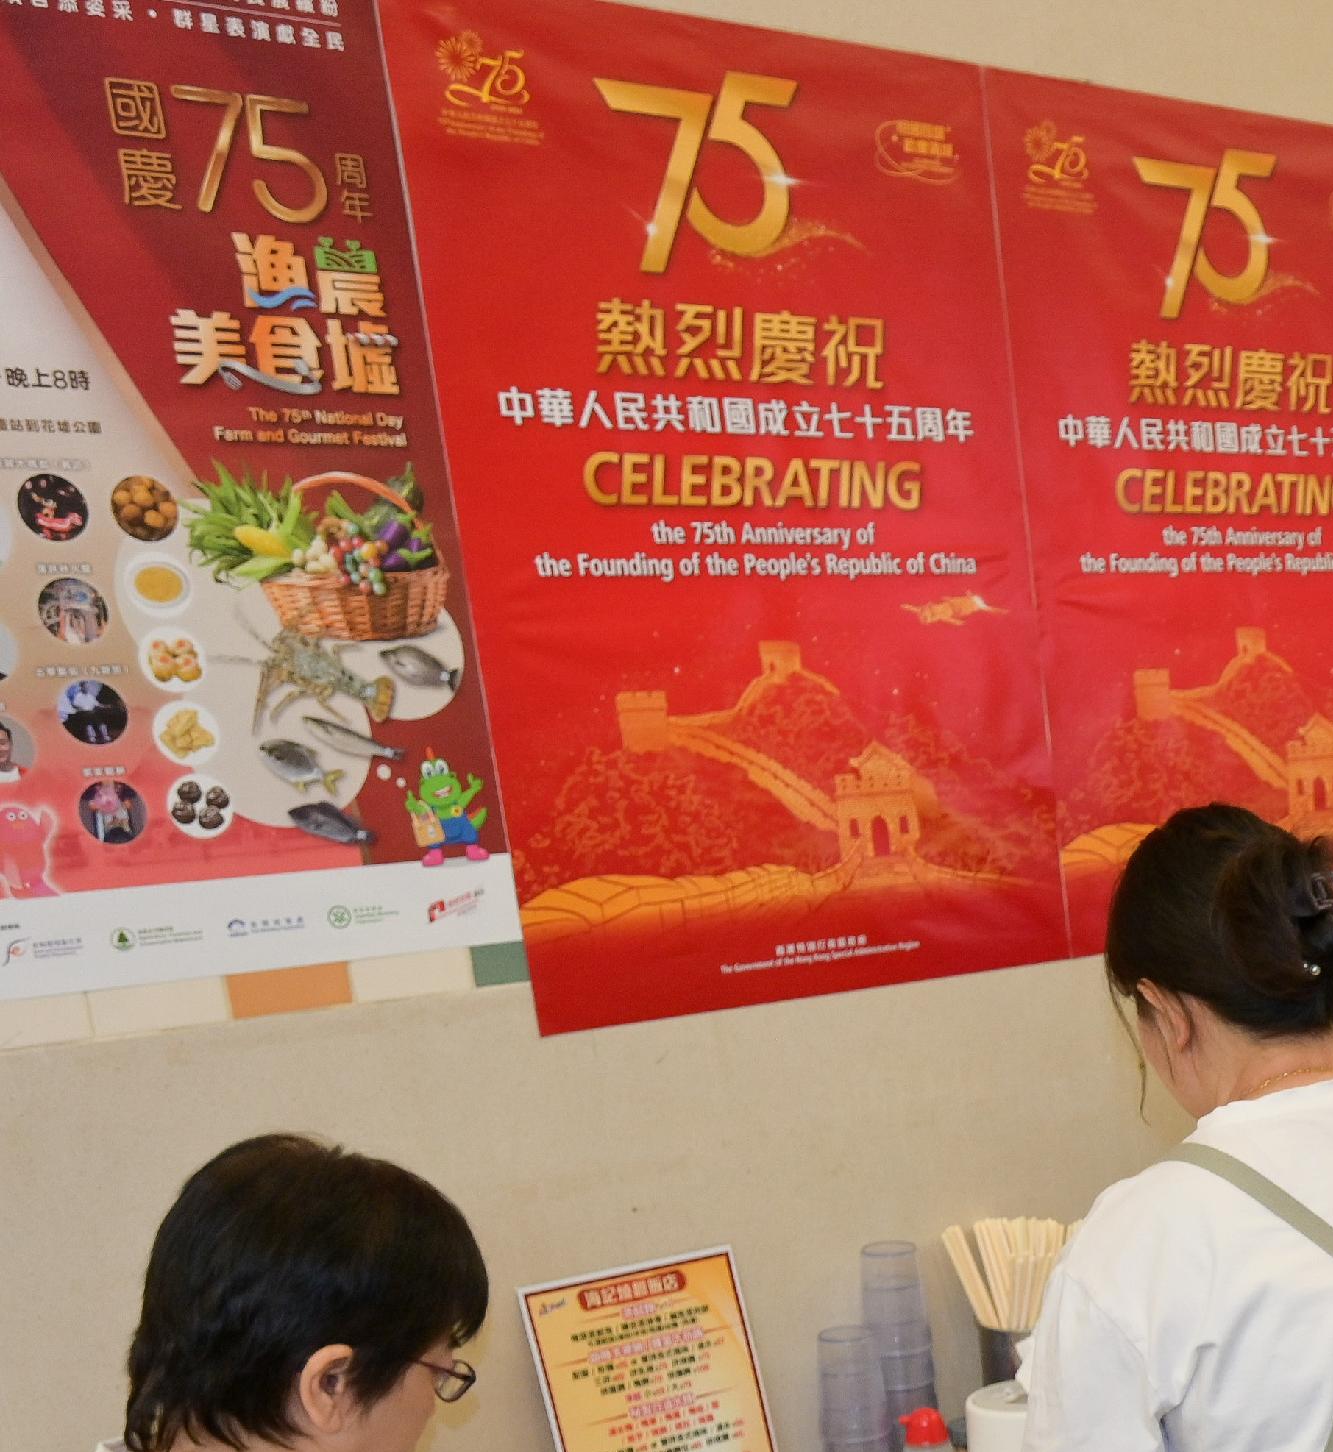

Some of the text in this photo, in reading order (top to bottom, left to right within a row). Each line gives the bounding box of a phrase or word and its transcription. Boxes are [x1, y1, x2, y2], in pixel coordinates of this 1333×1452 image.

[104, 77, 182, 210] 國慶
[170, 84, 327, 223] 75
[593, 70, 798, 273] 75
[334, 153, 373, 223] 周年
[1132, 148, 1279, 320] 75
[594, 297, 886, 390] 熱烈慶祝
[5, 368, 90, 390] 晚上8時
[213, 425, 408, 447] Farm and Gourmet Festival
[248, 406, 277, 423] The
[314, 409, 373, 427] National
[375, 411, 403, 430] Day
[497, 384, 975, 444] 中華人民共和國成立七十五周年
[582, 451, 922, 511] CELEBRATING
[651, 521, 876, 550] the 75th Anniversary of
[1080, 552, 1106, 573] the
[1109, 552, 1179, 577] Founding
[1182, 552, 1197, 573] of
[1200, 552, 1224, 573] the
[1227, 552, 1282, 576] People's
[1162, 525, 1322, 550] the 75th Anniversary of
[534, 552, 977, 582] the Founding of the People's Republic of China
